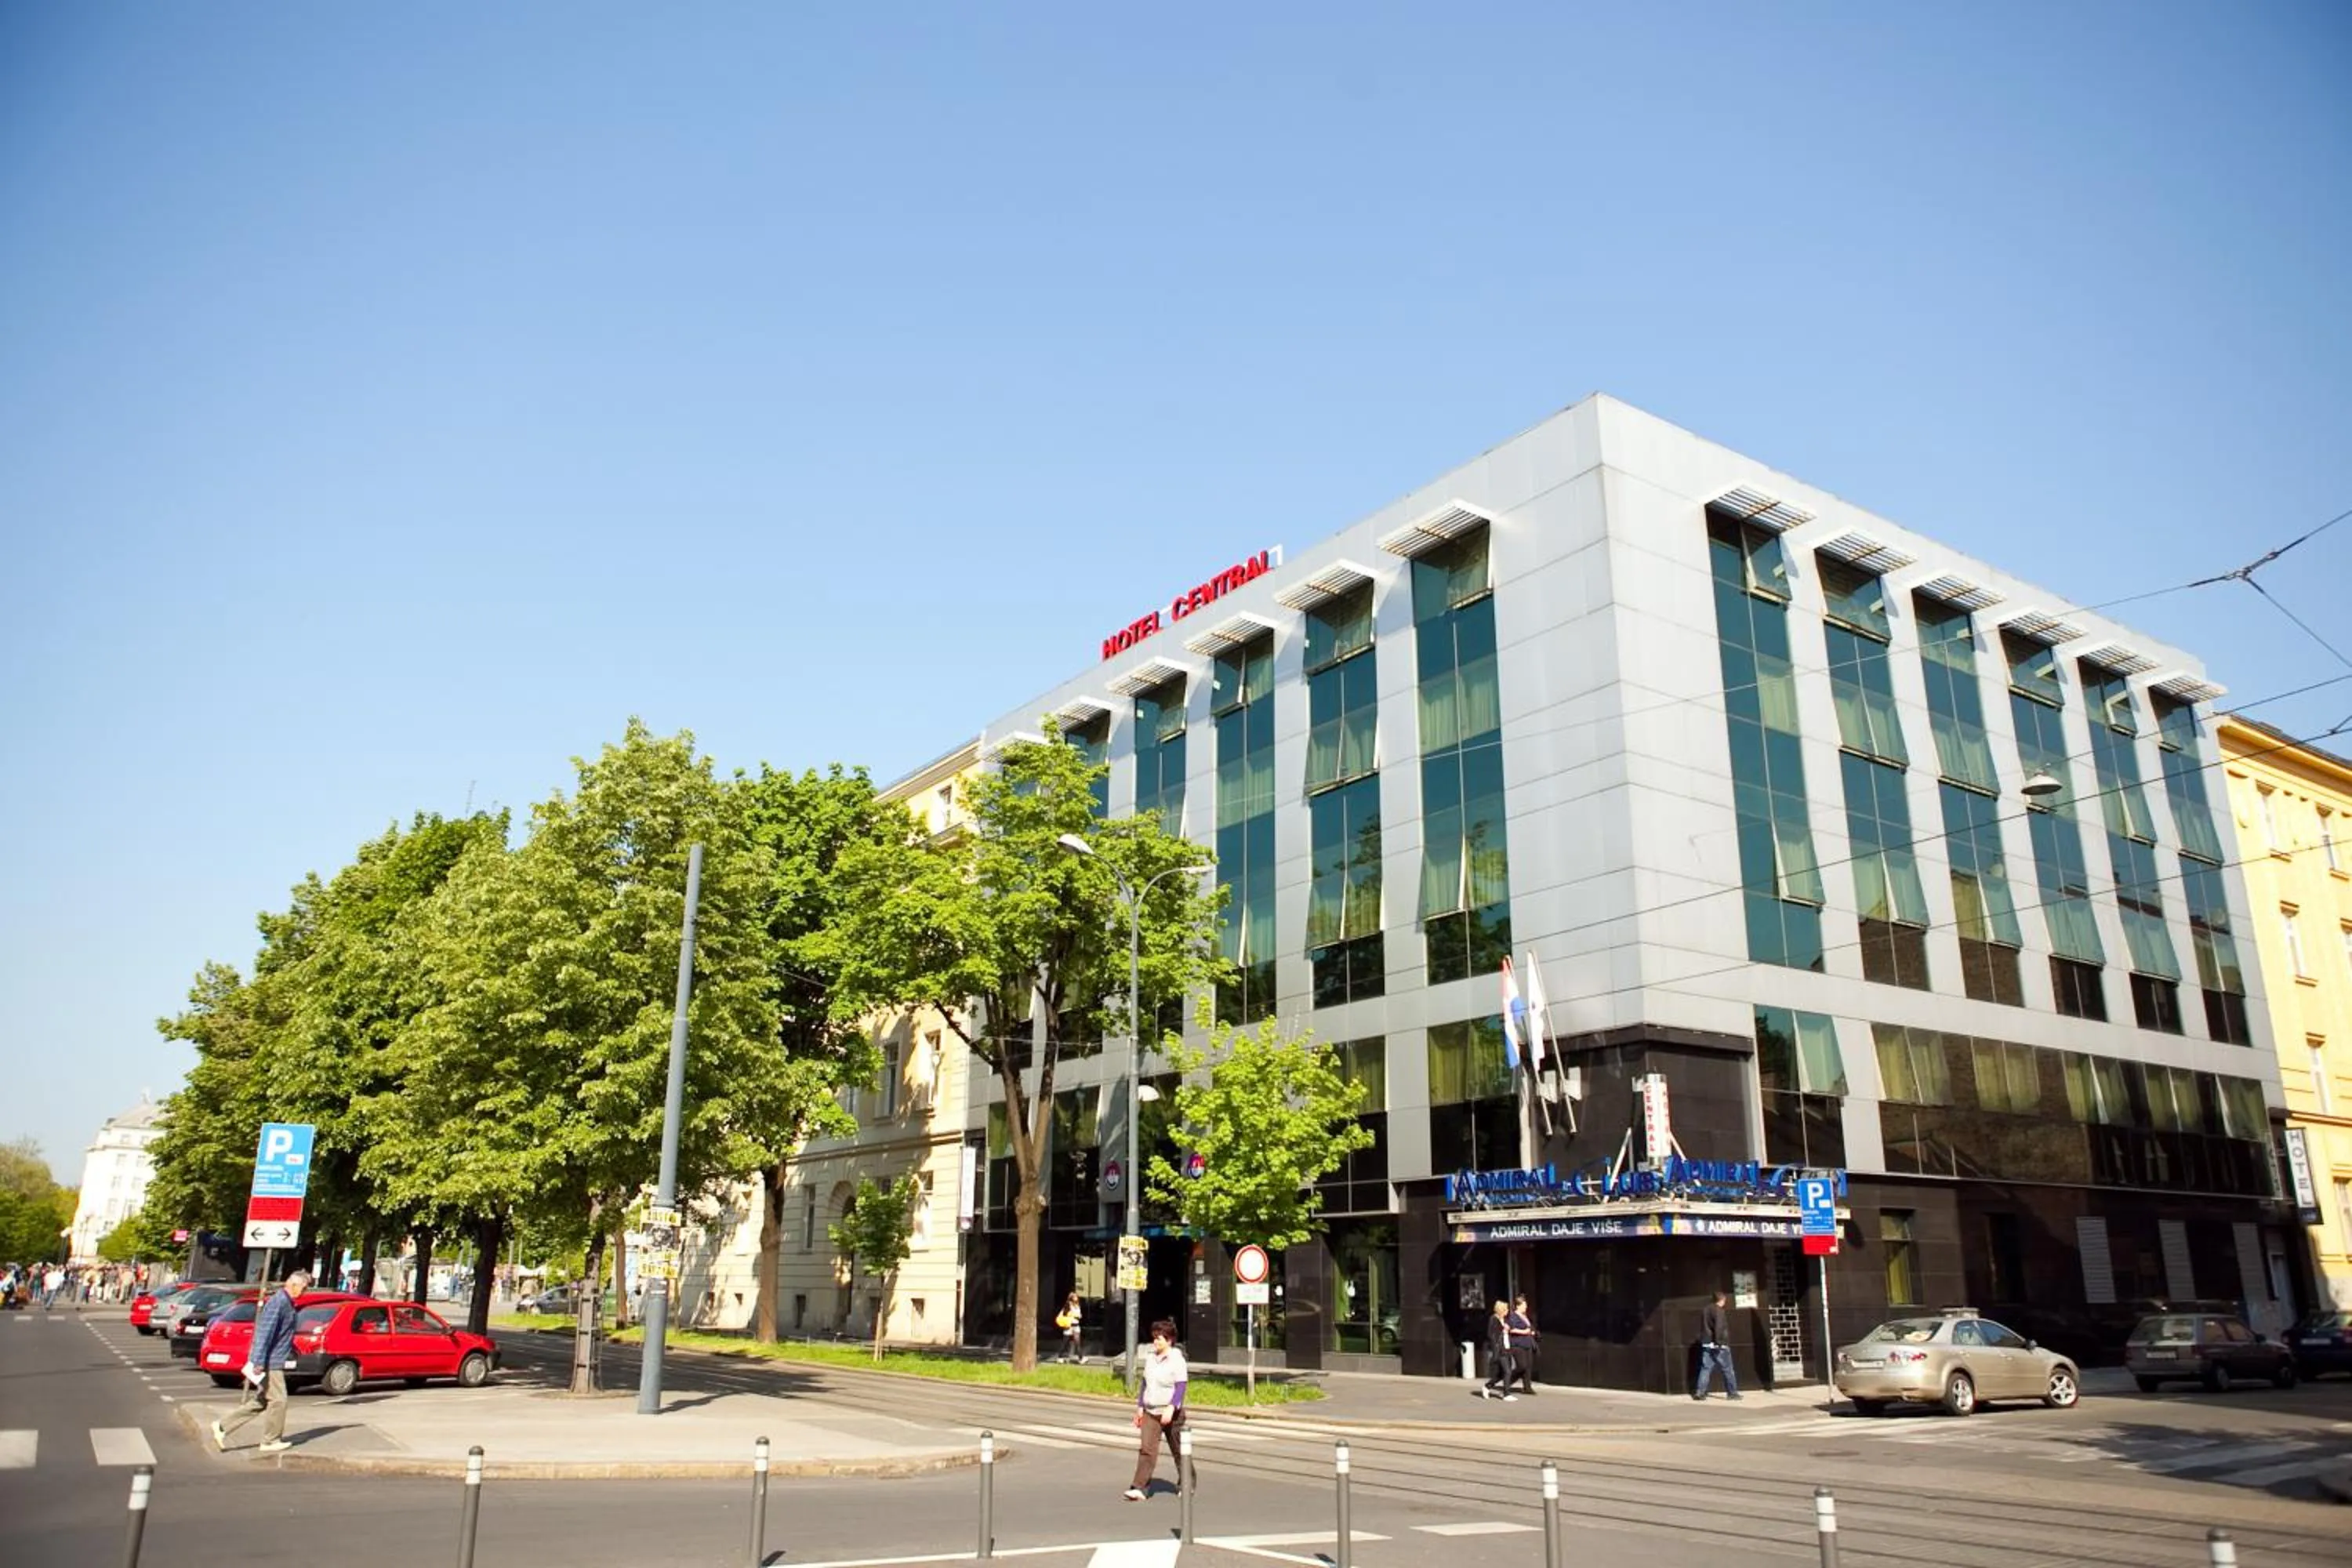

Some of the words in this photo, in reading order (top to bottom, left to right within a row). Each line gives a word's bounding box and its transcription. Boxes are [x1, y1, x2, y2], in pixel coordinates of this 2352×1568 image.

[1102, 610, 1163, 662] HOTEL
[1171, 550, 1274, 622] CENTRAL
[1644, 1083, 1655, 1152] CENTRAL
[265, 1128, 293, 1162] P
[1455, 1161, 1571, 1201] ADMIRAL
[2288, 1131, 2312, 1205] HOTEL
[1807, 1181, 1824, 1208] P
[1490, 1223, 1547, 1239] ADMIRAL
[1552, 1222, 1584, 1236] DAJE
[1592, 1220, 1623, 1235] VIŠE
[1708, 1220, 1758, 1234] ADMIRAL
[1761, 1221, 1787, 1234] DAJE
